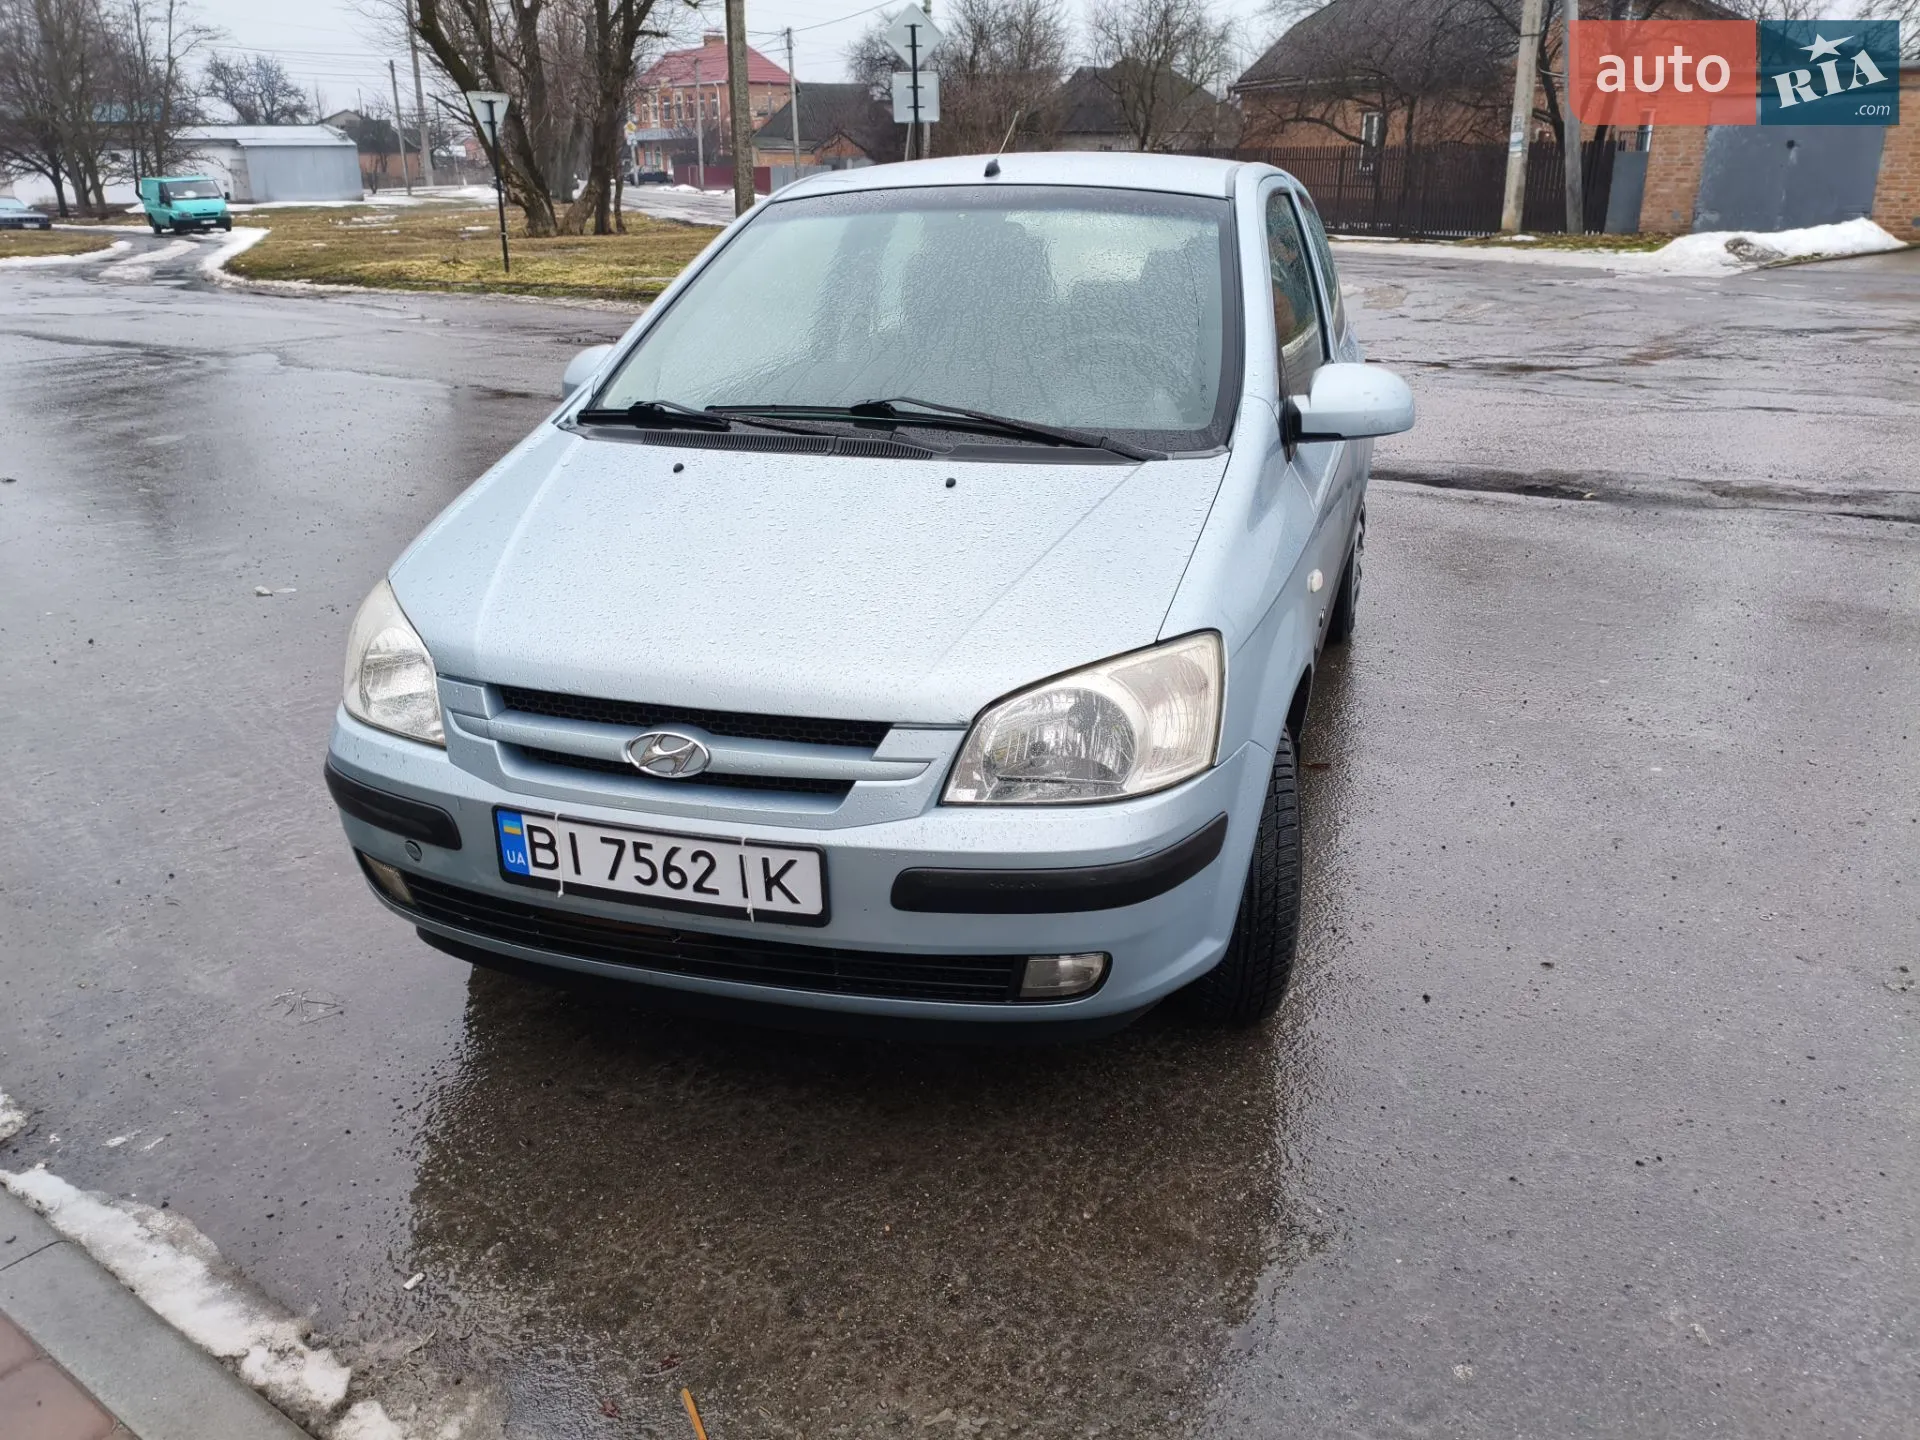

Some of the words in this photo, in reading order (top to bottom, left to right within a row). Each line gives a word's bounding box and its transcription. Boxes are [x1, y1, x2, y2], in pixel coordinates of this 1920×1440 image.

[507, 850, 527, 867] UA
[527, 824, 582, 876] BI
[600, 836, 719, 895] 7562
[739, 854, 801, 904] IK
